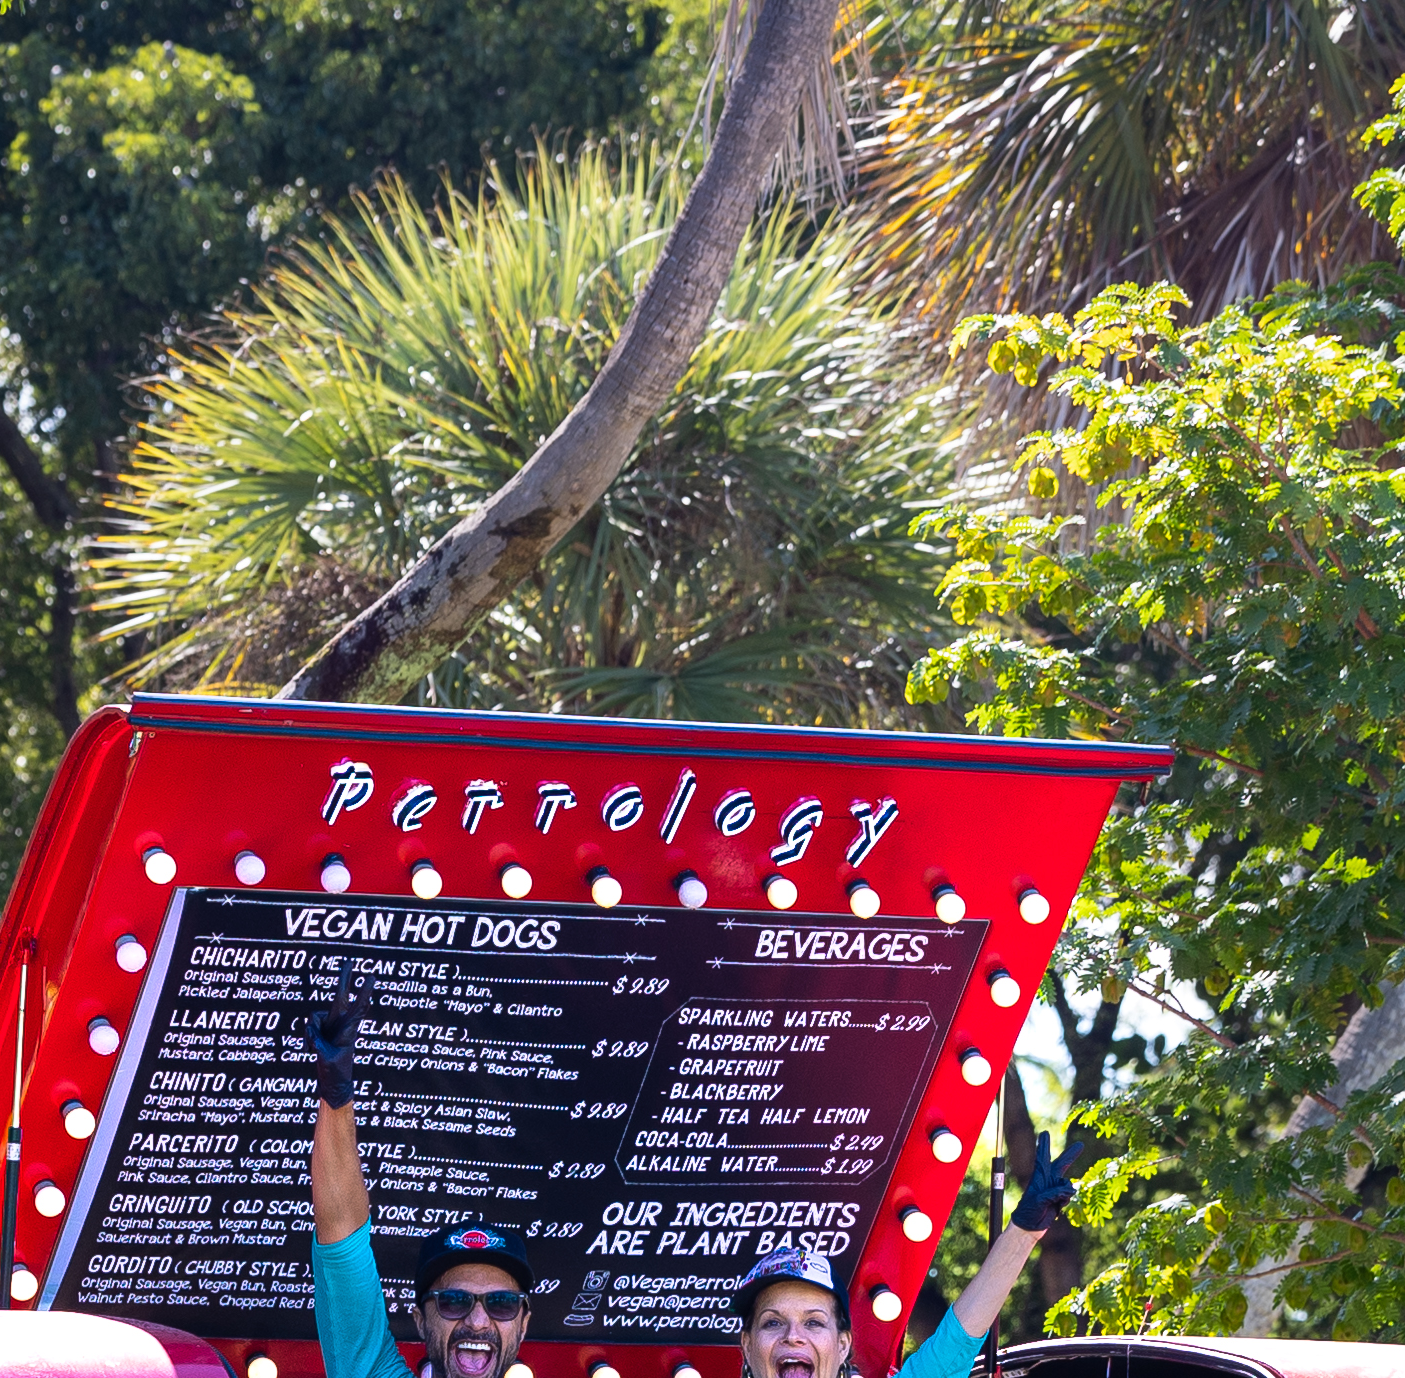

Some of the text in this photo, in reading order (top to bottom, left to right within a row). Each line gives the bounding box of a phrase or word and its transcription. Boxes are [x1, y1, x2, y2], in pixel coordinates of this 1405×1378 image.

[321, 757, 899, 867] Perrology
[285, 908, 561, 951] VEGAN HOT DOGS
[754, 929, 929, 963] BEVERAGES
[184, 969, 239, 985] Original
[431, 984, 449, 995] as
[452, 986, 462, 996] a
[178, 984, 231, 999] Pickled
[379, 994, 439, 1010] Chipotle
[492, 1003, 504, 1014] &
[507, 1003, 563, 1017] Cilantro
[678, 1007, 774, 1028] SPARKLING
[405, 1023, 458, 1042] STYLE
[686, 1033, 791, 1053] RASPBERRY
[163, 1031, 216, 1048] Original
[354, 1037, 429, 1054] Guasacaca
[479, 1047, 508, 1061] Pink
[374, 1054, 418, 1071] Crispy
[420, 1057, 465, 1072] Onions
[467, 1061, 479, 1073] &
[536, 1067, 579, 1081] Flakes
[679, 1057, 784, 1077] GRAPEFRUIT
[239, 1077, 318, 1093] GANGNAM
[669, 1082, 784, 1101] BLACKBERRY
[143, 1093, 196, 1109] Original
[260, 1095, 300, 1111] Vegan
[380, 1100, 391, 1112] &
[393, 1101, 433, 1118] Spicy
[434, 1104, 473, 1118] Asian
[660, 1106, 871, 1125] HALF TEA HALF LEMON
[137, 1109, 196, 1123] Sriracha
[370, 1115, 381, 1127] &
[383, 1116, 419, 1129] Black
[421, 1118, 473, 1134] Sesame
[475, 1122, 517, 1138] Seeds
[357, 1142, 406, 1160] STYLE
[122, 1155, 175, 1171] Original
[239, 1156, 279, 1172] Vegan
[378, 1161, 443, 1179] Pineapple
[117, 1170, 145, 1183] Pink
[195, 1172, 248, 1184] Cilantro
[380, 1177, 425, 1192] Onions
[427, 1181, 438, 1193] &
[495, 1186, 538, 1200] Flakes
[233, 1199, 264, 1214] OLD
[377, 1204, 419, 1222] YORK
[602, 1201, 861, 1228] OUR INGREDIENTS
[102, 1216, 154, 1232] Original
[219, 1217, 258, 1233] Vegan
[96, 1231, 288, 1246] Sauerkraut & Brown Mustard
[585, 1228, 851, 1257] ARE PLANT BASED
[184, 1260, 247, 1276] CHUBBY
[248, 1261, 300, 1278] STYLE
[81, 1276, 133, 1292] Original
[198, 1278, 238, 1294] Vegan
[77, 1291, 125, 1304] Walnut
[126, 1292, 164, 1304] Pesto
[219, 1294, 278, 1310] Chopped
[278, 1296, 306, 1309] Red
